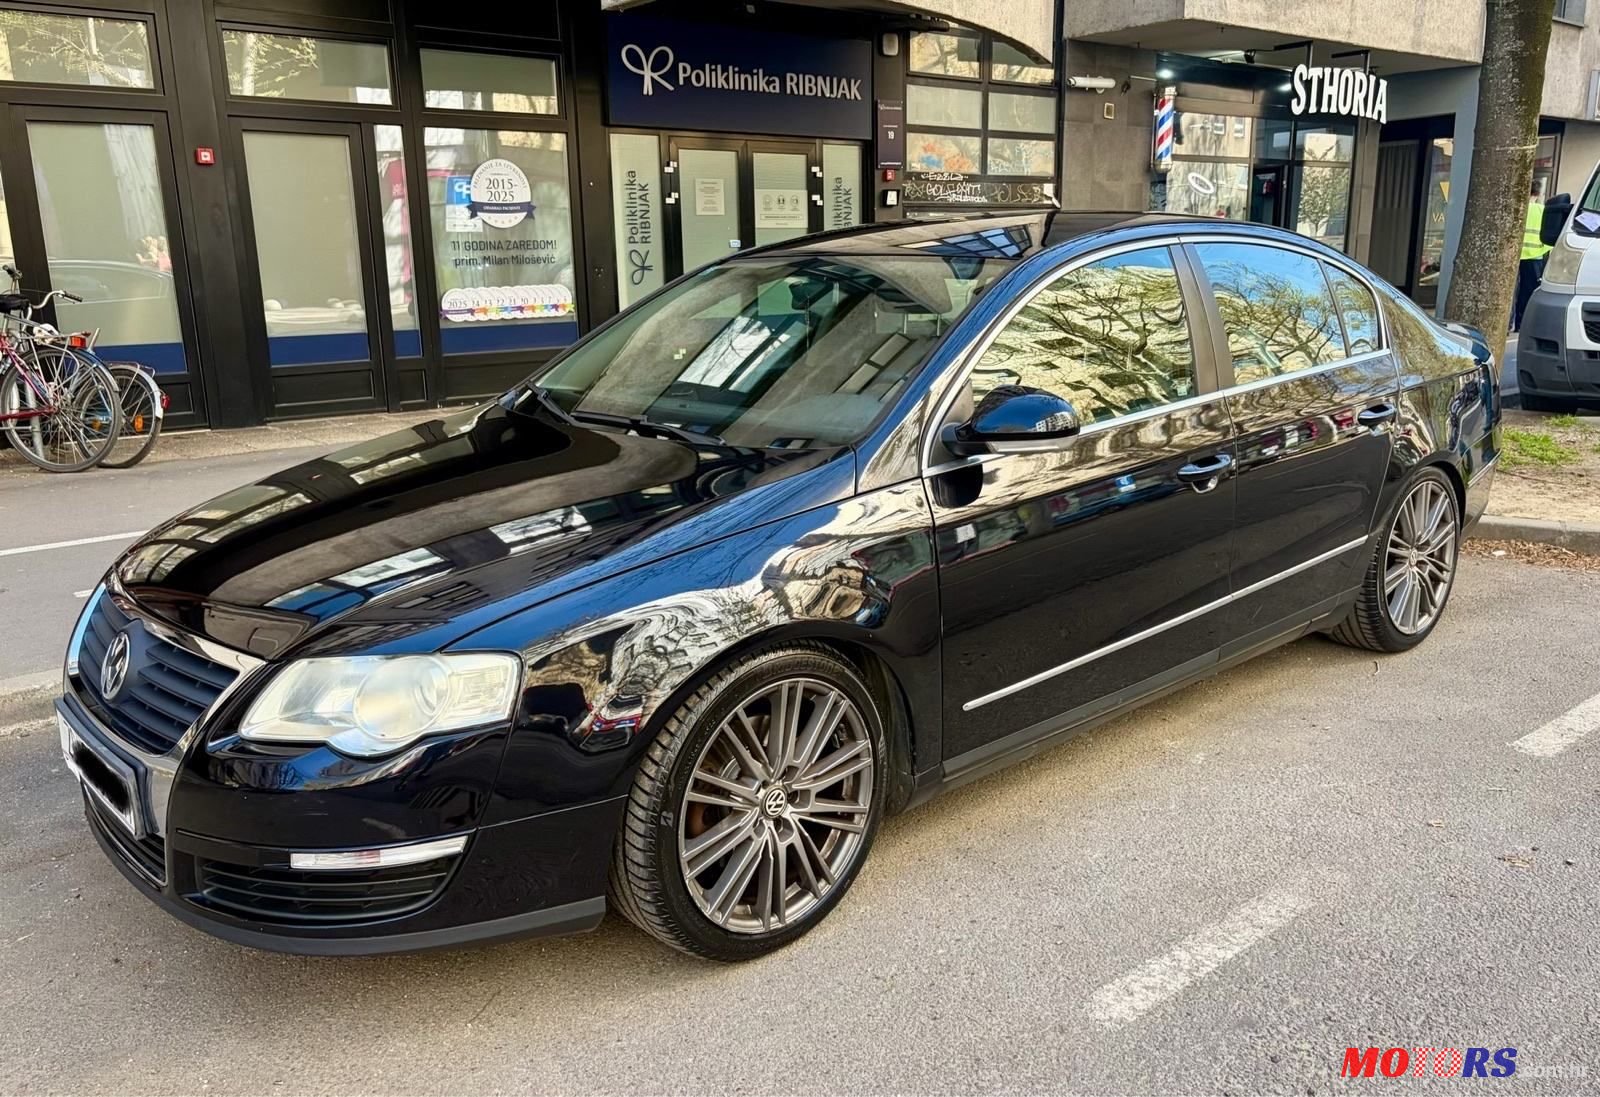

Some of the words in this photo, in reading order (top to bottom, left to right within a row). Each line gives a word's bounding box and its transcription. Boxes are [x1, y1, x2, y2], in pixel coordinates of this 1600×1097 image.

[678, 62, 781, 94] Poliklinika
[786, 72, 862, 101] RIBNJAK
[1291, 63, 1388, 125] STHORIA
[887, 130, 895, 140] 19
[486, 178, 518, 190] 2015-
[487, 190, 515, 202] 2025
[832, 176, 843, 229] liklinika
[624, 169, 640, 245] Poliklinika
[638, 182, 652, 245] RIBNJAK
[843, 187, 853, 229] BNJAK
[451, 240, 461, 252] 11
[464, 240, 503, 252] GODINA
[505, 239, 557, 251] ZAREDOM!
[454, 255, 481, 269] prim.
[483, 254, 510, 266] Milan
[511, 253, 556, 265] Milošević
